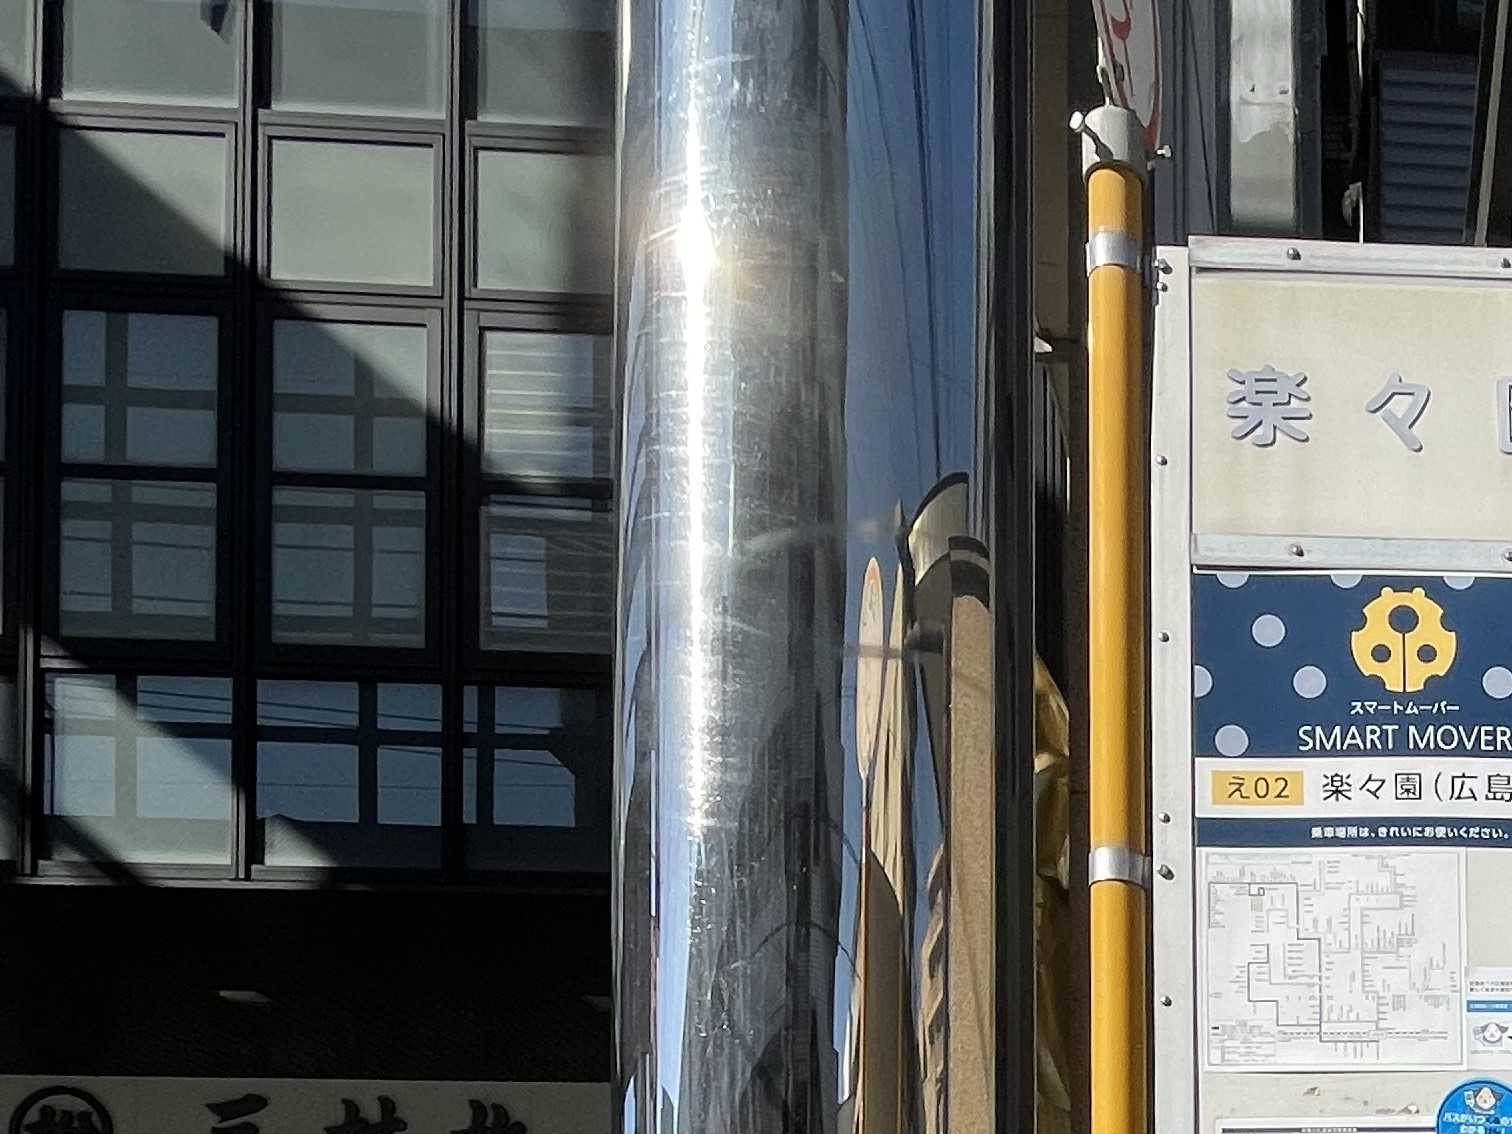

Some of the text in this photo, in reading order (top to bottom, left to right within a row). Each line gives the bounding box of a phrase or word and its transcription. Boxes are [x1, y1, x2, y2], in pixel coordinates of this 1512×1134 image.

[1350, 701, 1460, 715] スマートムーバー
[1298, 725, 1512, 751] SMART MOVER
[1226, 776, 1291, 801] え02
